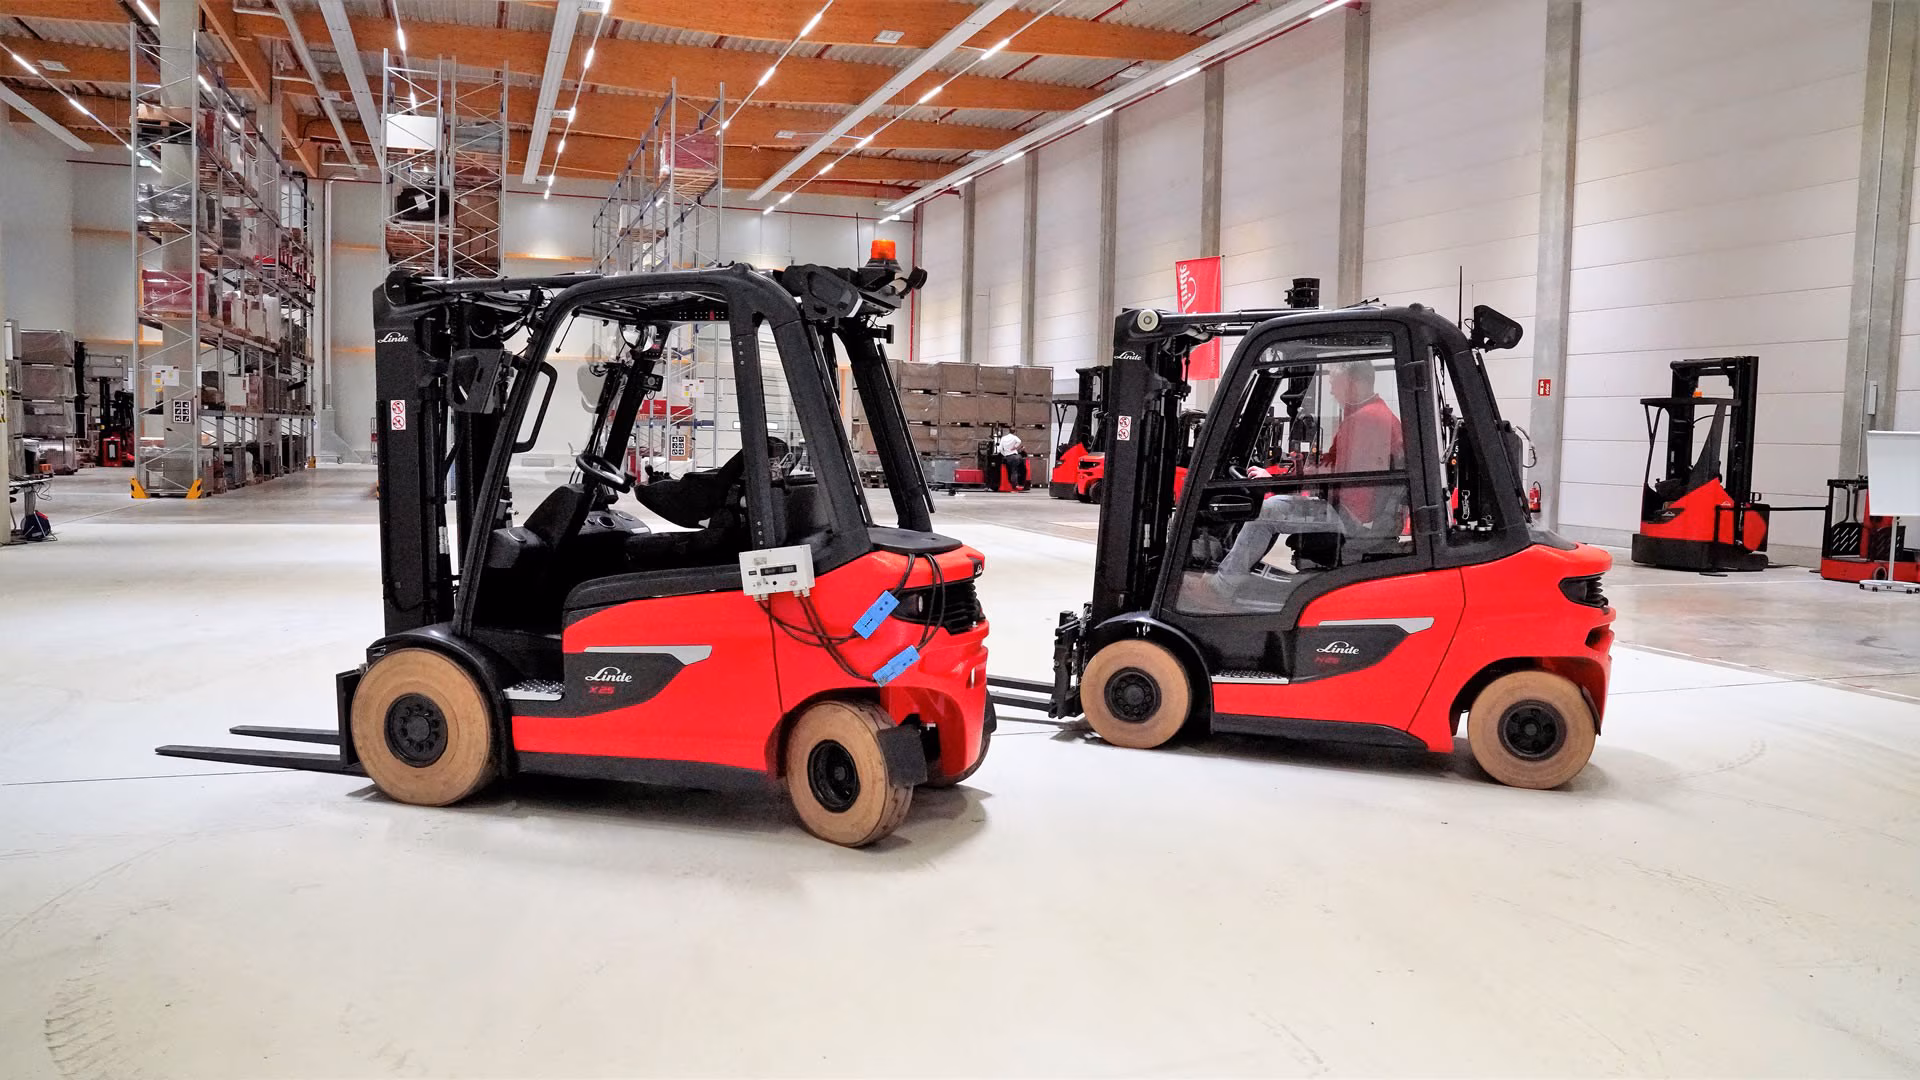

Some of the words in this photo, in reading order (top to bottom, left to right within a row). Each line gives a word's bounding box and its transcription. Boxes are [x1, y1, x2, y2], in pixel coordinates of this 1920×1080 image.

[377, 331, 409, 343] Linde
[1113, 350, 1142, 361] Linde
[1316, 640, 1360, 655] Linde
[584, 666, 633, 683] Linde
